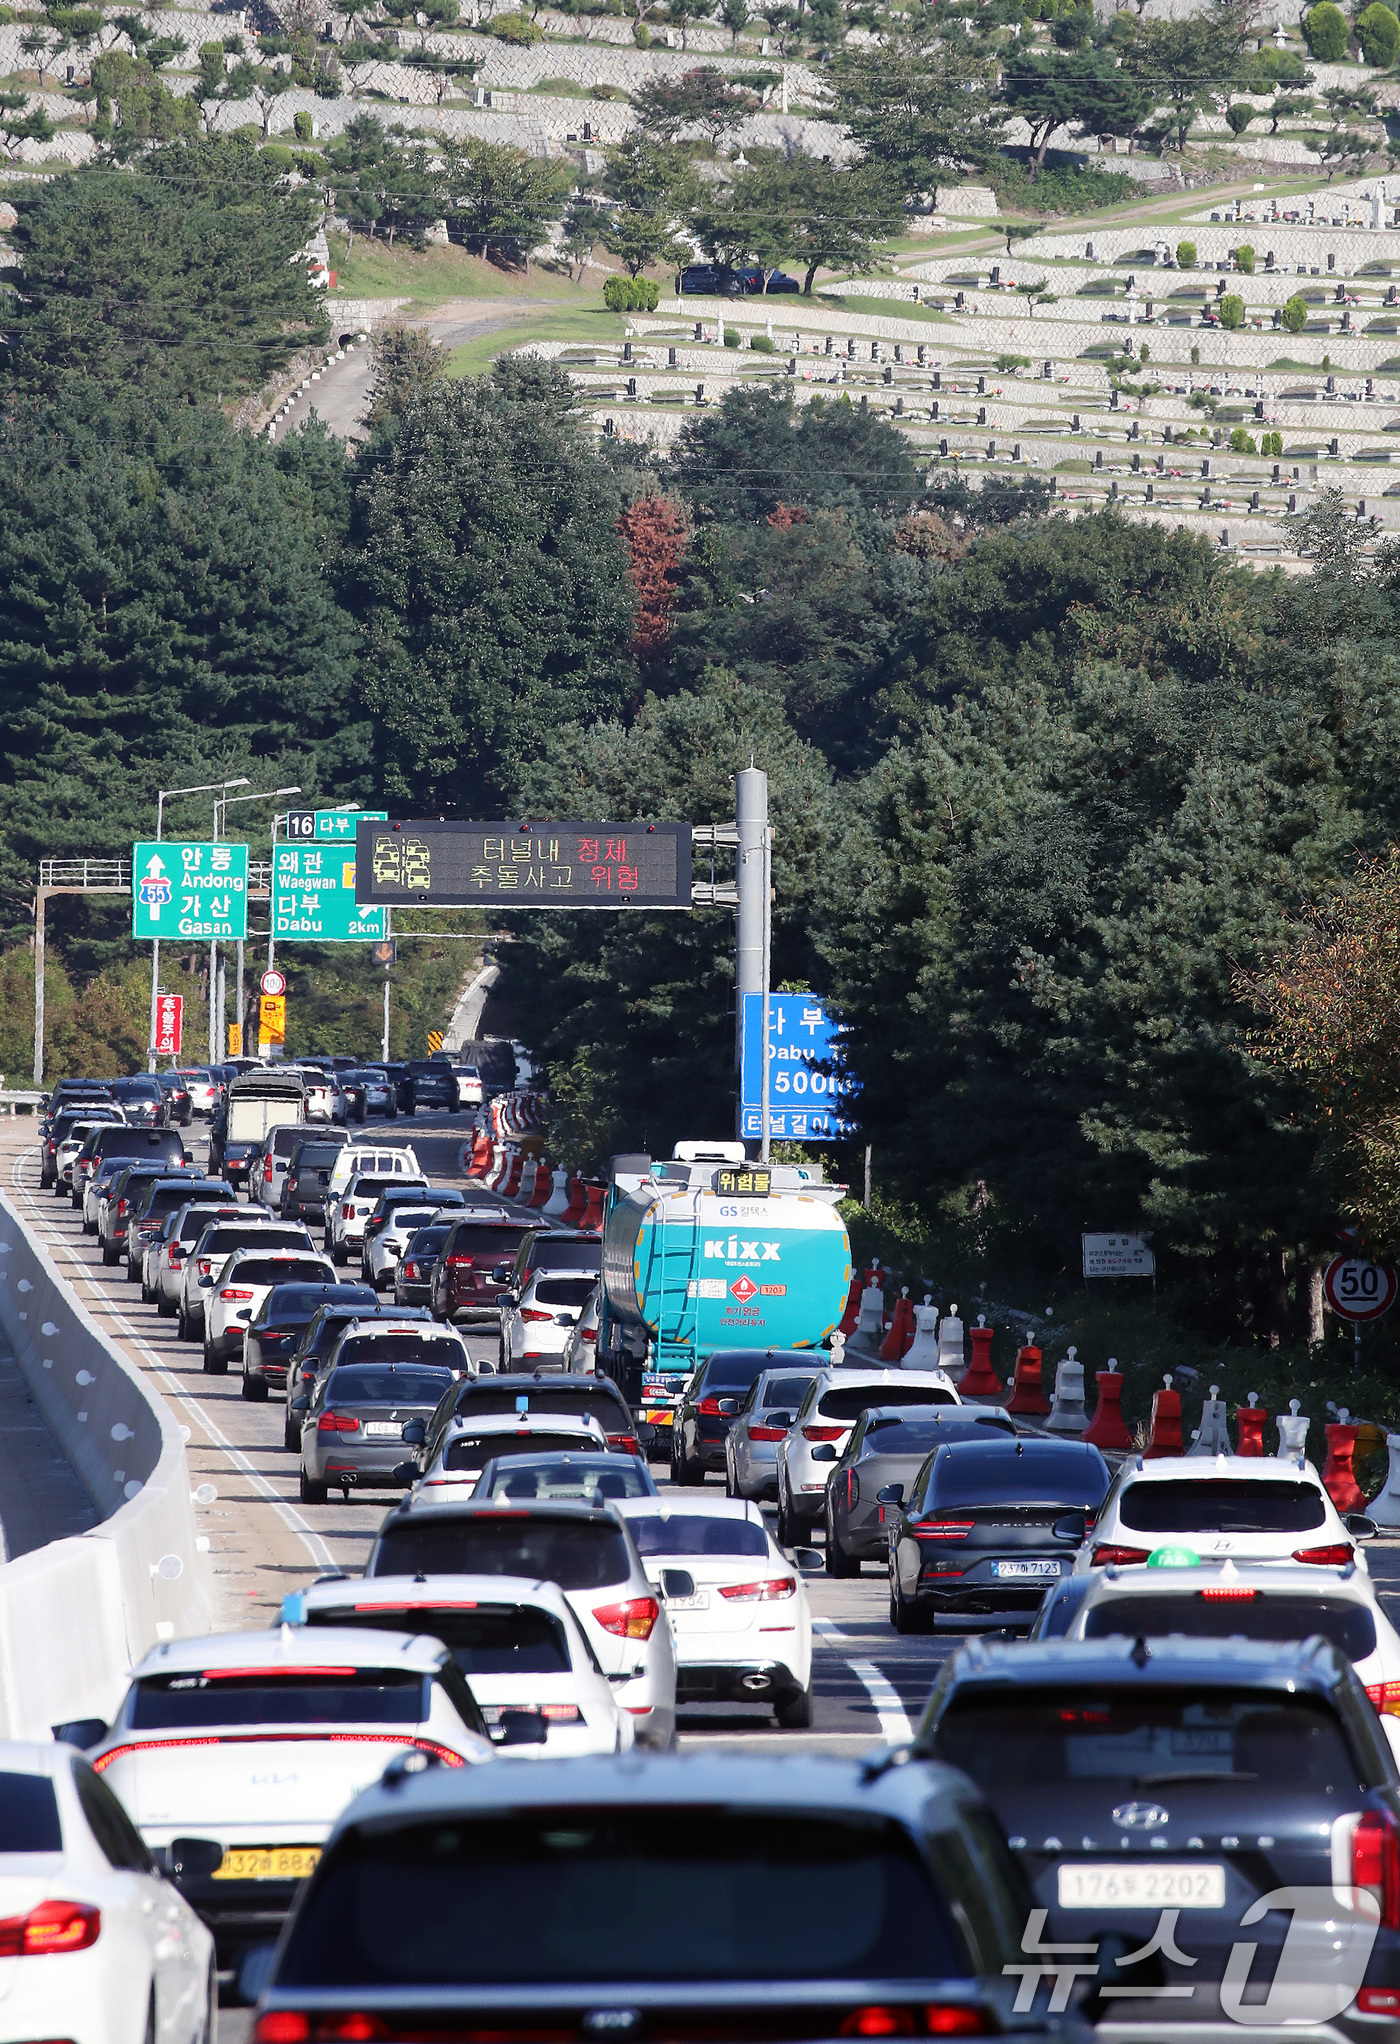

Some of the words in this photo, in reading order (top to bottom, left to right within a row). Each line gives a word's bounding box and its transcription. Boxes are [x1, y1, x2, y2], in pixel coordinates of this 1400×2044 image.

[291, 817, 313, 835] 16
[320, 817, 350, 834] 다부
[181, 847, 233, 872] 안동
[483, 838, 559, 863] 터널내
[577, 838, 627, 863] 정체
[278, 852, 323, 875] 왜관
[181, 872, 244, 892] Andong
[278, 875, 336, 891] Waegwan
[470, 865, 573, 889] 추돌사고
[589, 865, 639, 890] 위험
[147, 886, 166, 903] 55
[180, 894, 232, 918] 가산
[278, 894, 321, 917] 다부
[178, 918, 232, 935] Gasan
[277, 917, 322, 932] Dabu
[348, 921, 380, 934] 2km
[265, 978, 281, 989] 100
[160, 998, 176, 1051] 추돌주의
[720, 1172, 770, 1192] 위험물
[720, 1206, 738, 1217] GS
[740, 1206, 769, 1217] 칼텍스
[765, 1286, 782, 1294] 1203
[1341, 1267, 1378, 1295] 50
[1031, 1561, 1058, 1575] 7123
[1146, 1873, 1211, 1896] 2202
